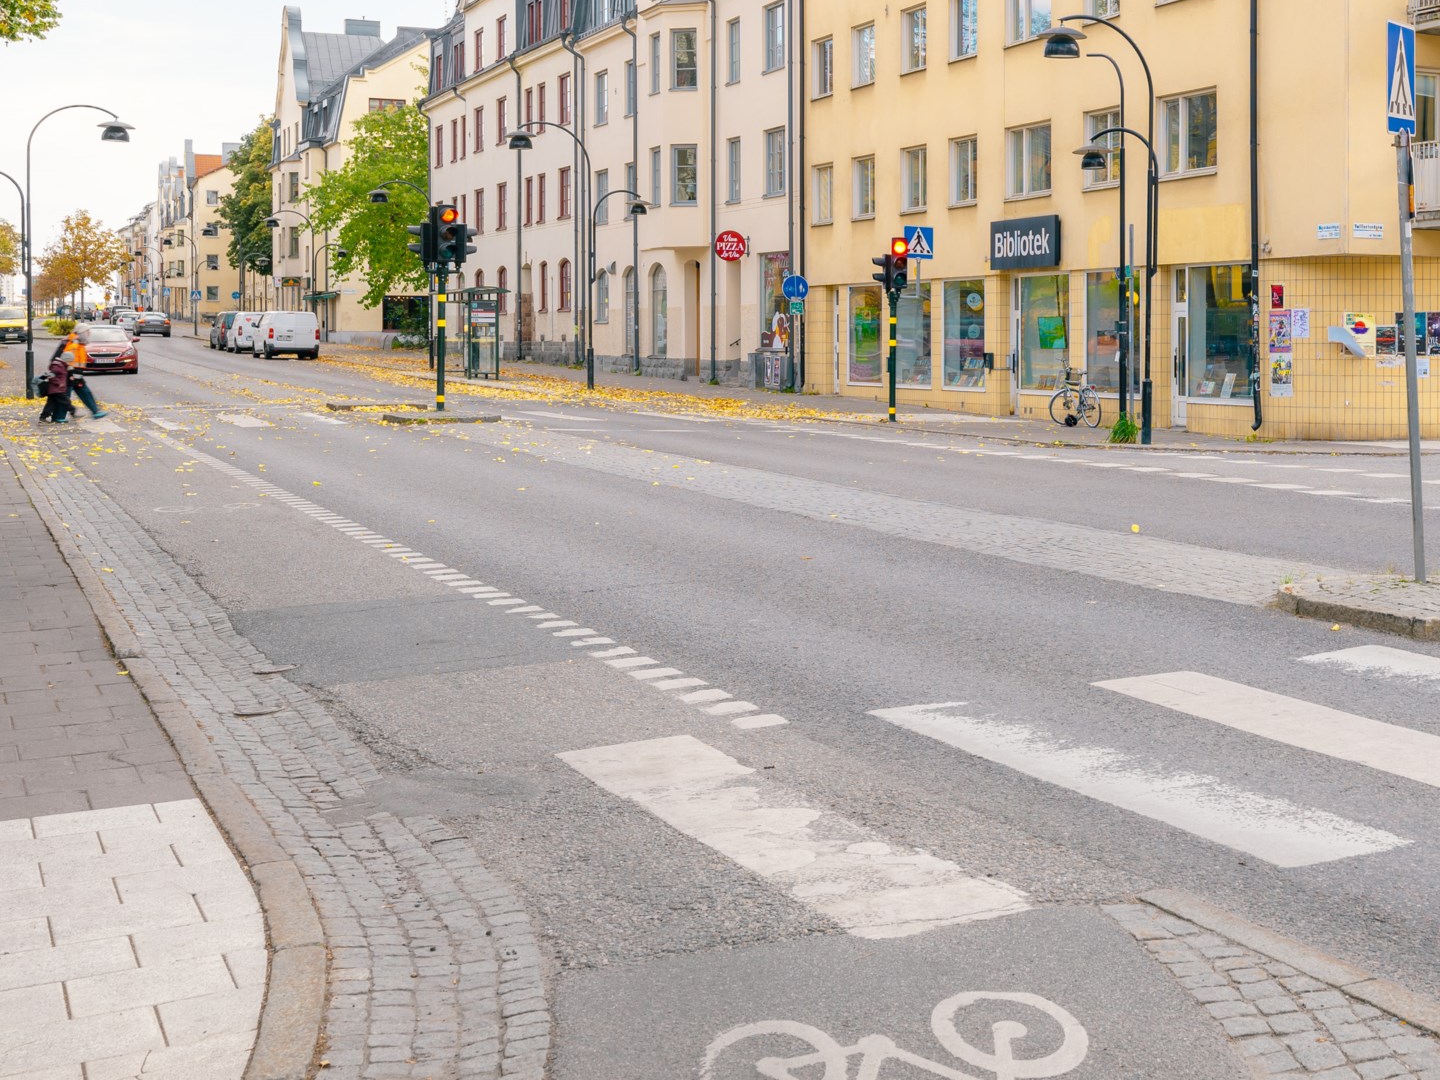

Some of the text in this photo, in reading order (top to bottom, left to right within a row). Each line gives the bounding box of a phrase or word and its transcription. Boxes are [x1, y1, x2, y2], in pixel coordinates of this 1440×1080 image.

[716, 241, 744, 251] PIZZA
[994, 227, 1050, 258] Bibliotek
[1427, 336, 1438, 345] LYLE
